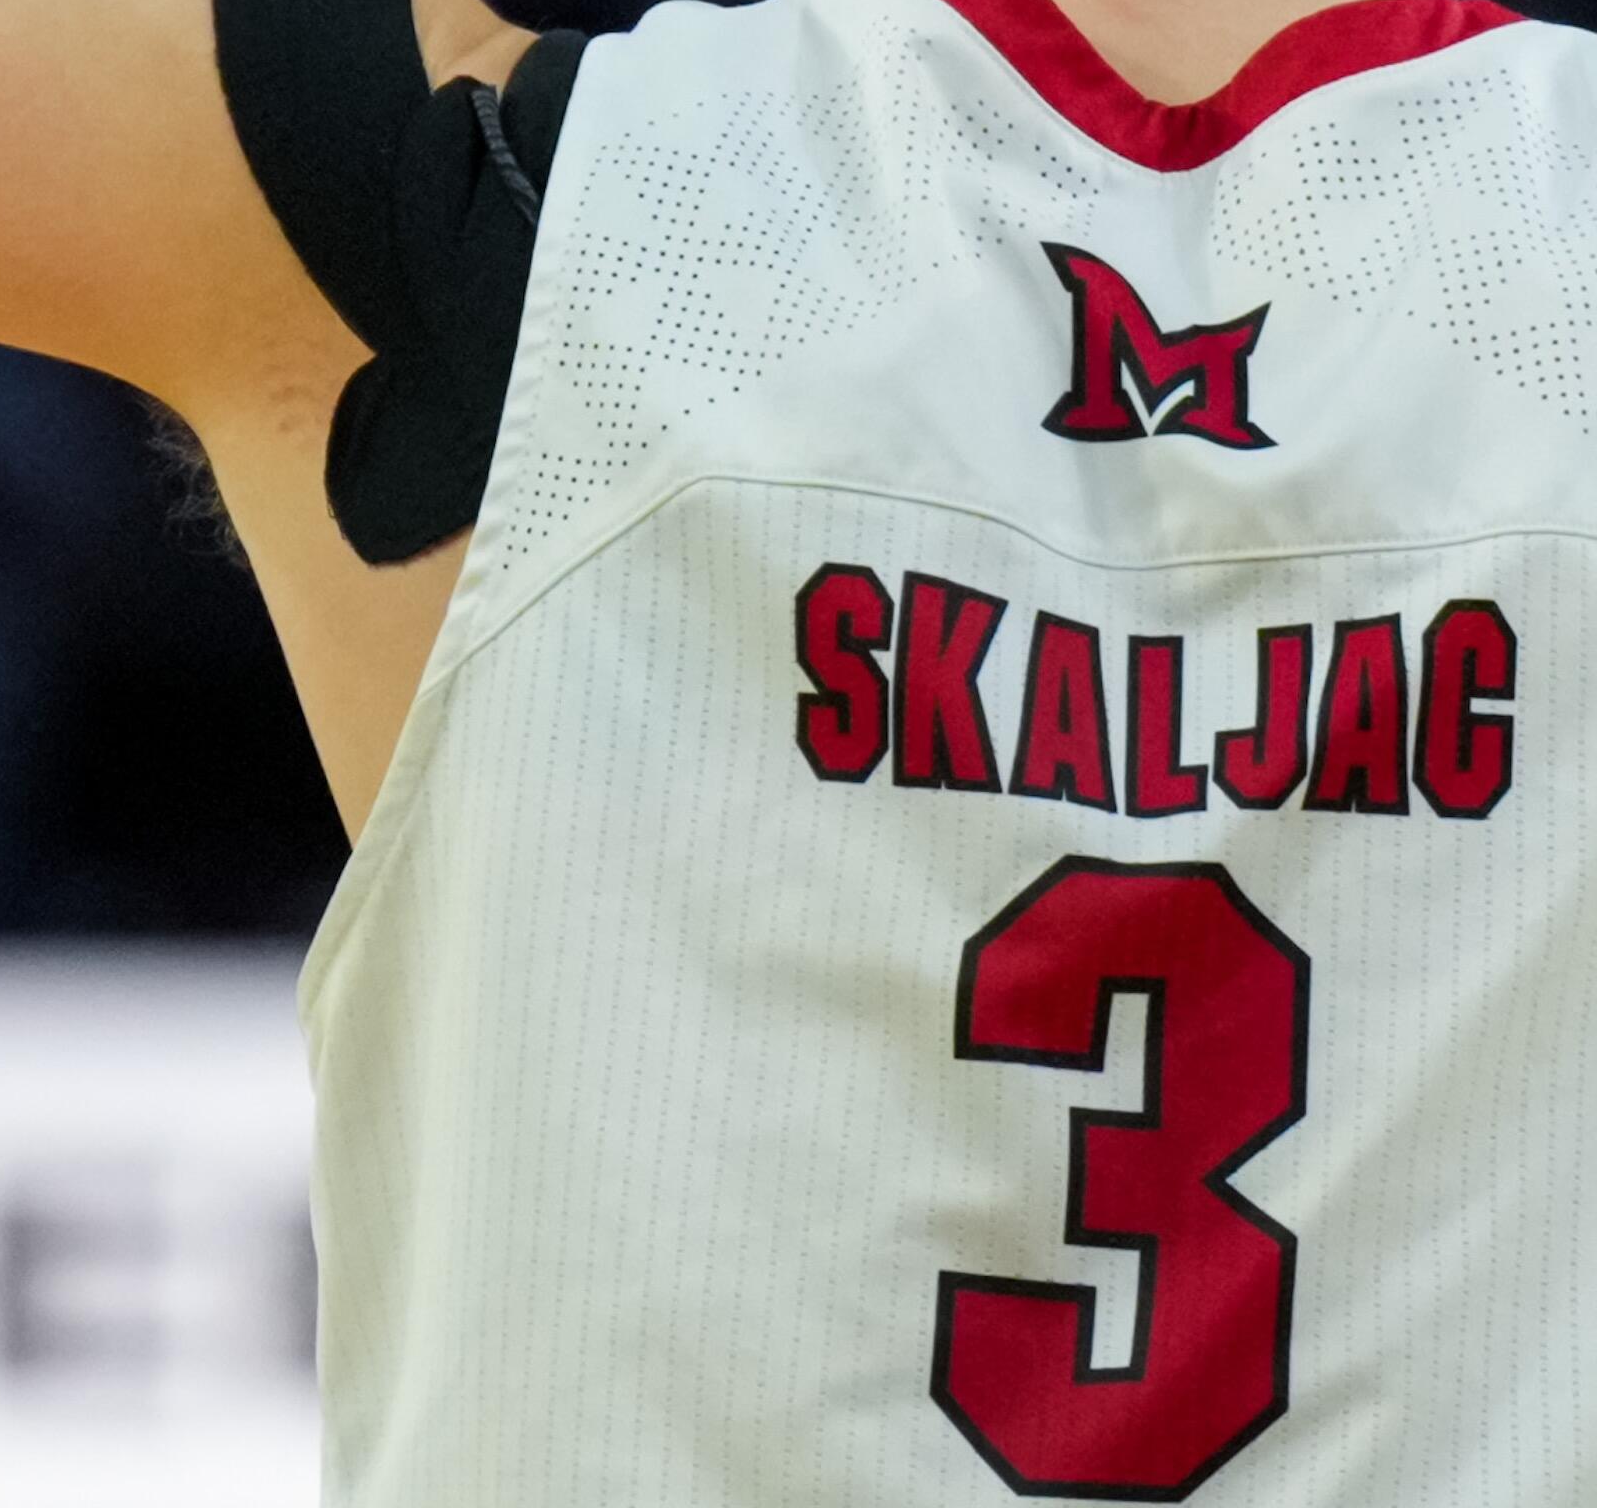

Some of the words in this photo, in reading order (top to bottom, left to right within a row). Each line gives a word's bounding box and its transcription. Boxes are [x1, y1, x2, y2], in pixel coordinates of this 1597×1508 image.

[1041, 242, 1278, 449] M
[796, 562, 1517, 819] SKALJAC
[930, 856, 1311, 1501] 3
